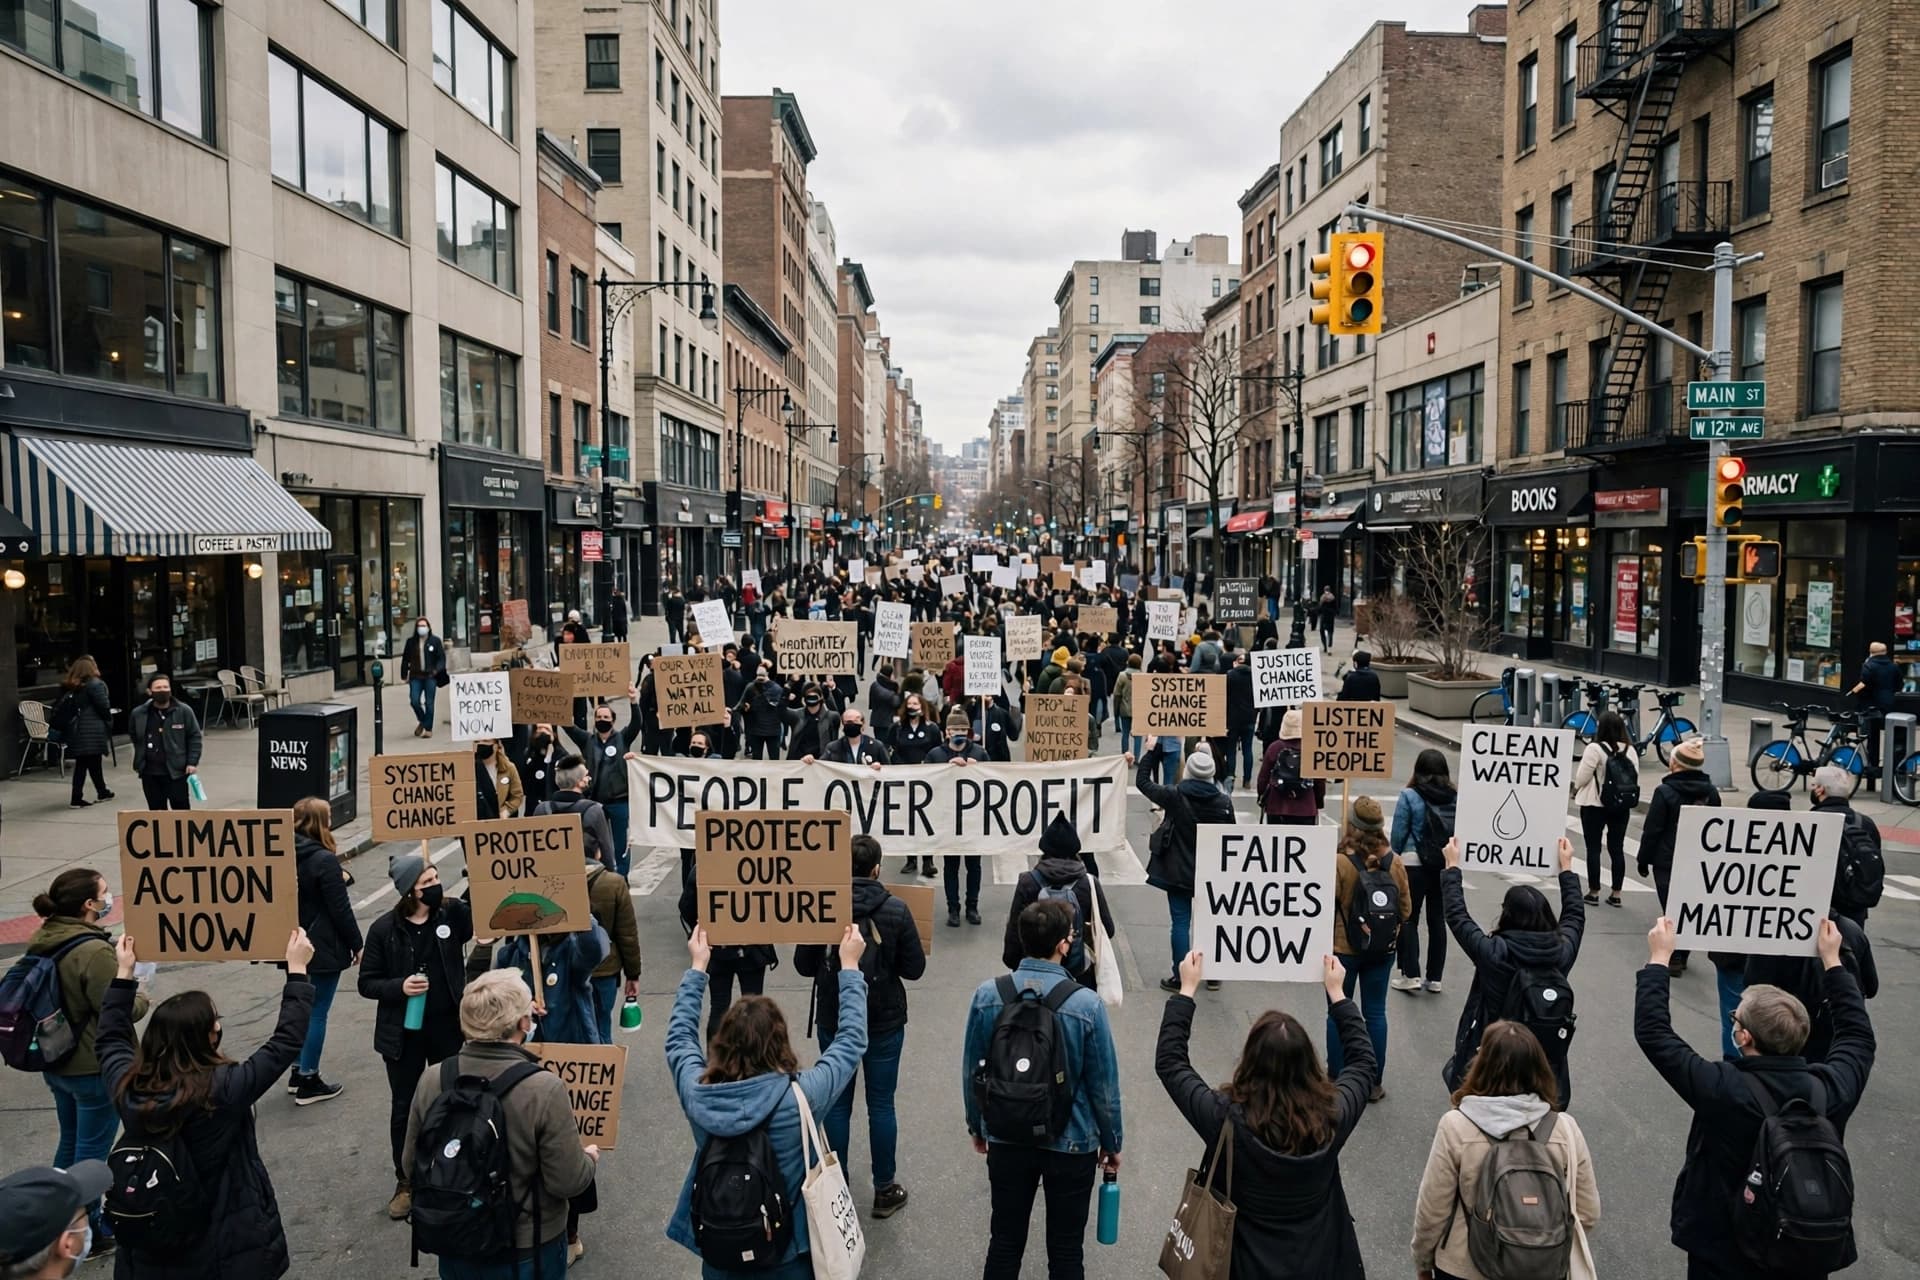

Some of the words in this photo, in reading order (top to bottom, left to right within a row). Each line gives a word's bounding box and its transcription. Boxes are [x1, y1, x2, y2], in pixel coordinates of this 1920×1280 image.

[1695, 387, 1736, 404] MAIN
[1746, 388, 1761, 401] ST
[1695, 421, 1706, 436] W
[1711, 420, 1736, 437] 12TH
[1741, 422, 1760, 434] AVE
[1741, 473, 1799, 496] RMACY
[1511, 487, 1557, 512] BOOKS
[198, 537, 235, 551] COFFEE
[922, 626, 944, 637] OUR
[1257, 652, 1313, 670] JUSTICE
[669, 671, 708, 685] CLEAN
[1151, 677, 1206, 693] SYSTEM
[1260, 668, 1313, 685] CHANGE
[666, 684, 715, 701] WATER
[1150, 694, 1208, 709] CHANGE
[1260, 684, 1316, 703] MATTERS
[667, 703, 689, 717] FOR
[693, 701, 716, 715] ALL
[1147, 711, 1207, 728] CHANGE
[1313, 706, 1384, 728] LISTEN
[459, 717, 494, 736] NOW
[270, 740, 309, 755] DAILY
[1313, 730, 1338, 748] TO
[1342, 730, 1380, 749] THE
[1471, 730, 1559, 759] CLEAN
[270, 756, 308, 771] NEWS
[1313, 750, 1386, 773] PEOPLE
[384, 763, 456, 785] SYSTEM
[1471, 759, 1560, 788] WATER
[392, 784, 455, 804] CHANGE
[386, 805, 457, 830] CHANGE
[824, 779, 935, 836] OVER
[955, 777, 1113, 836] PROFIT
[125, 818, 285, 860] CLIMATE
[474, 826, 573, 857] PROTECT
[705, 817, 842, 852] PROTECT
[1700, 817, 1818, 857] CLEAN
[1221, 834, 1307, 874] FAIR
[1465, 842, 1503, 865] FOR
[1508, 845, 1551, 869] ALL
[490, 856, 539, 881] OUR
[737, 856, 794, 885] OUR
[1700, 861, 1801, 898] VOICE
[133, 865, 273, 906] ACTION
[709, 890, 837, 924] FUTURE
[1205, 881, 1322, 918] WAGES
[158, 912, 256, 953] NOW
[1676, 902, 1816, 941] MATTERS
[1214, 924, 1312, 965] NOW
[543, 1060, 616, 1086] SYSTEM
[568, 1089, 613, 1112] NGE
[574, 1115, 606, 1137] NGE
